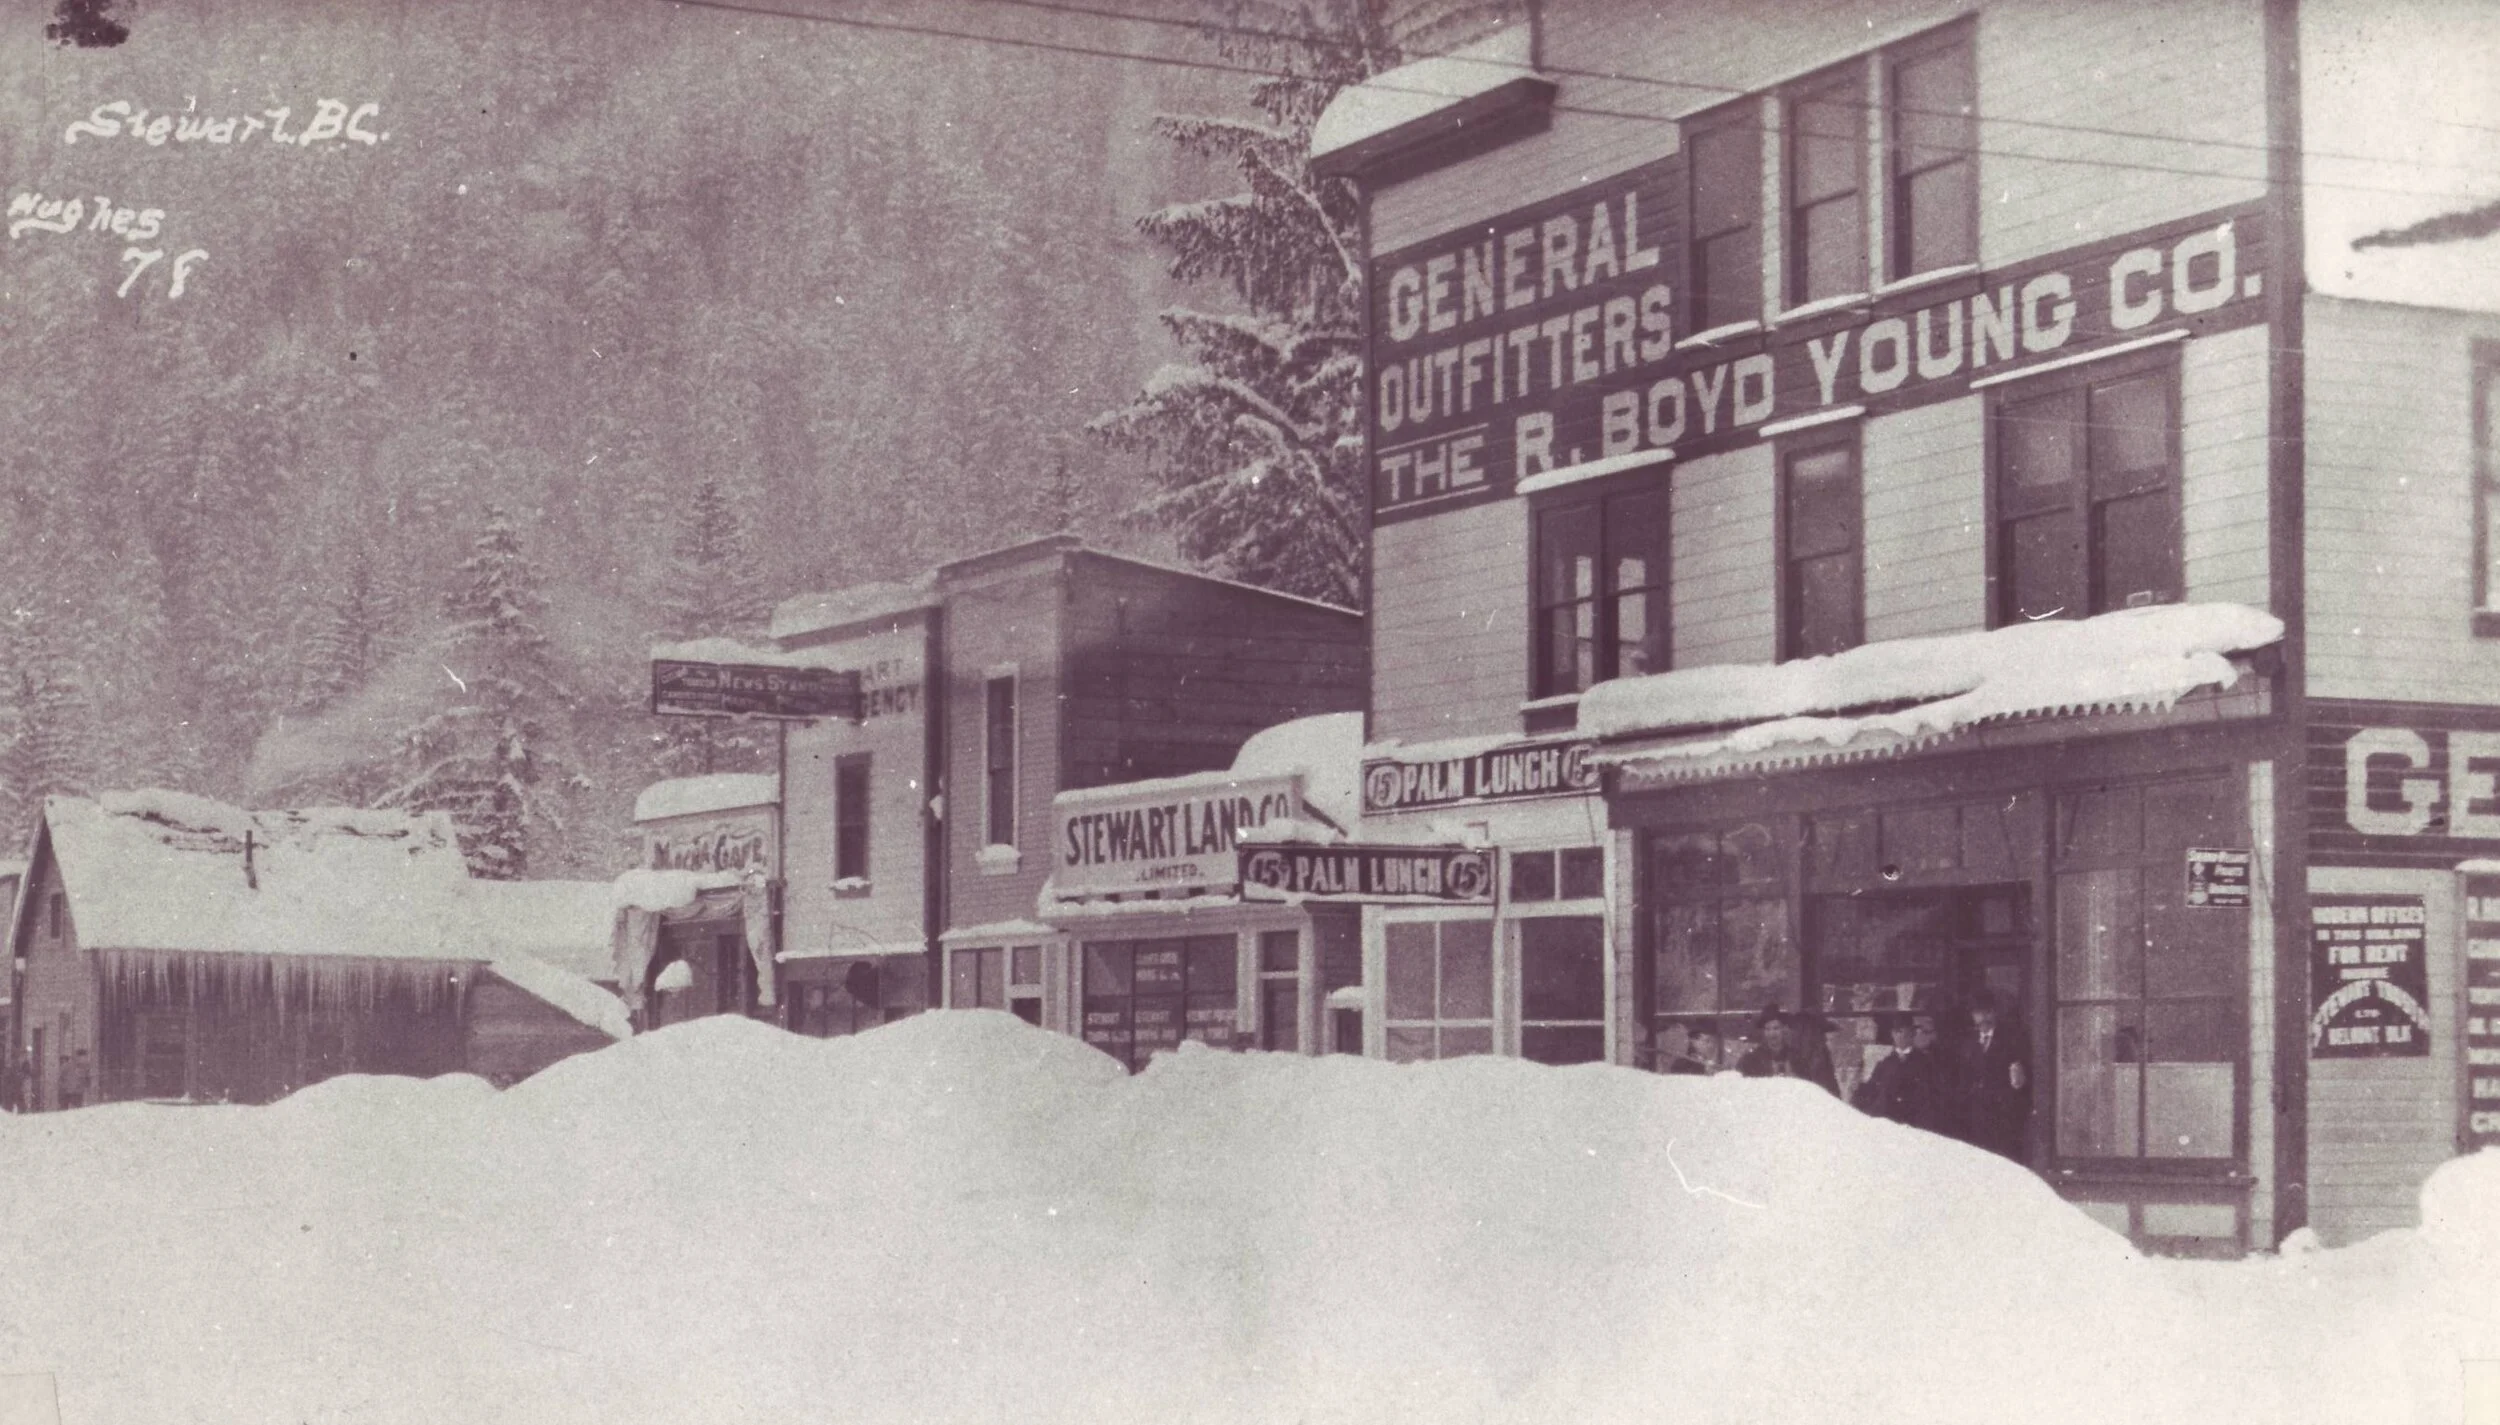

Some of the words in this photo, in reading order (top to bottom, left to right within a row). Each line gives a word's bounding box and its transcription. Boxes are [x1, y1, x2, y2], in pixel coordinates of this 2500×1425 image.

[1388, 191, 1661, 343] GENERAL
[1378, 284, 1673, 432] OUTFITTERS
[1379, 434, 1485, 500] THE
[1515, 411, 1582, 480] R.
[1602, 353, 1775, 458] BOYD
[1806, 272, 2077, 405] YOUNG
[2109, 222, 2263, 332] CO.
[1402, 759, 1465, 803] PALM
[1474, 748, 1560, 797] LUNCH
[1065, 805, 1179, 867] STEWART
[1184, 797, 1254, 855] LAND
[1295, 856, 1360, 893] PALM
[1370, 857, 1443, 894] LUNCH
